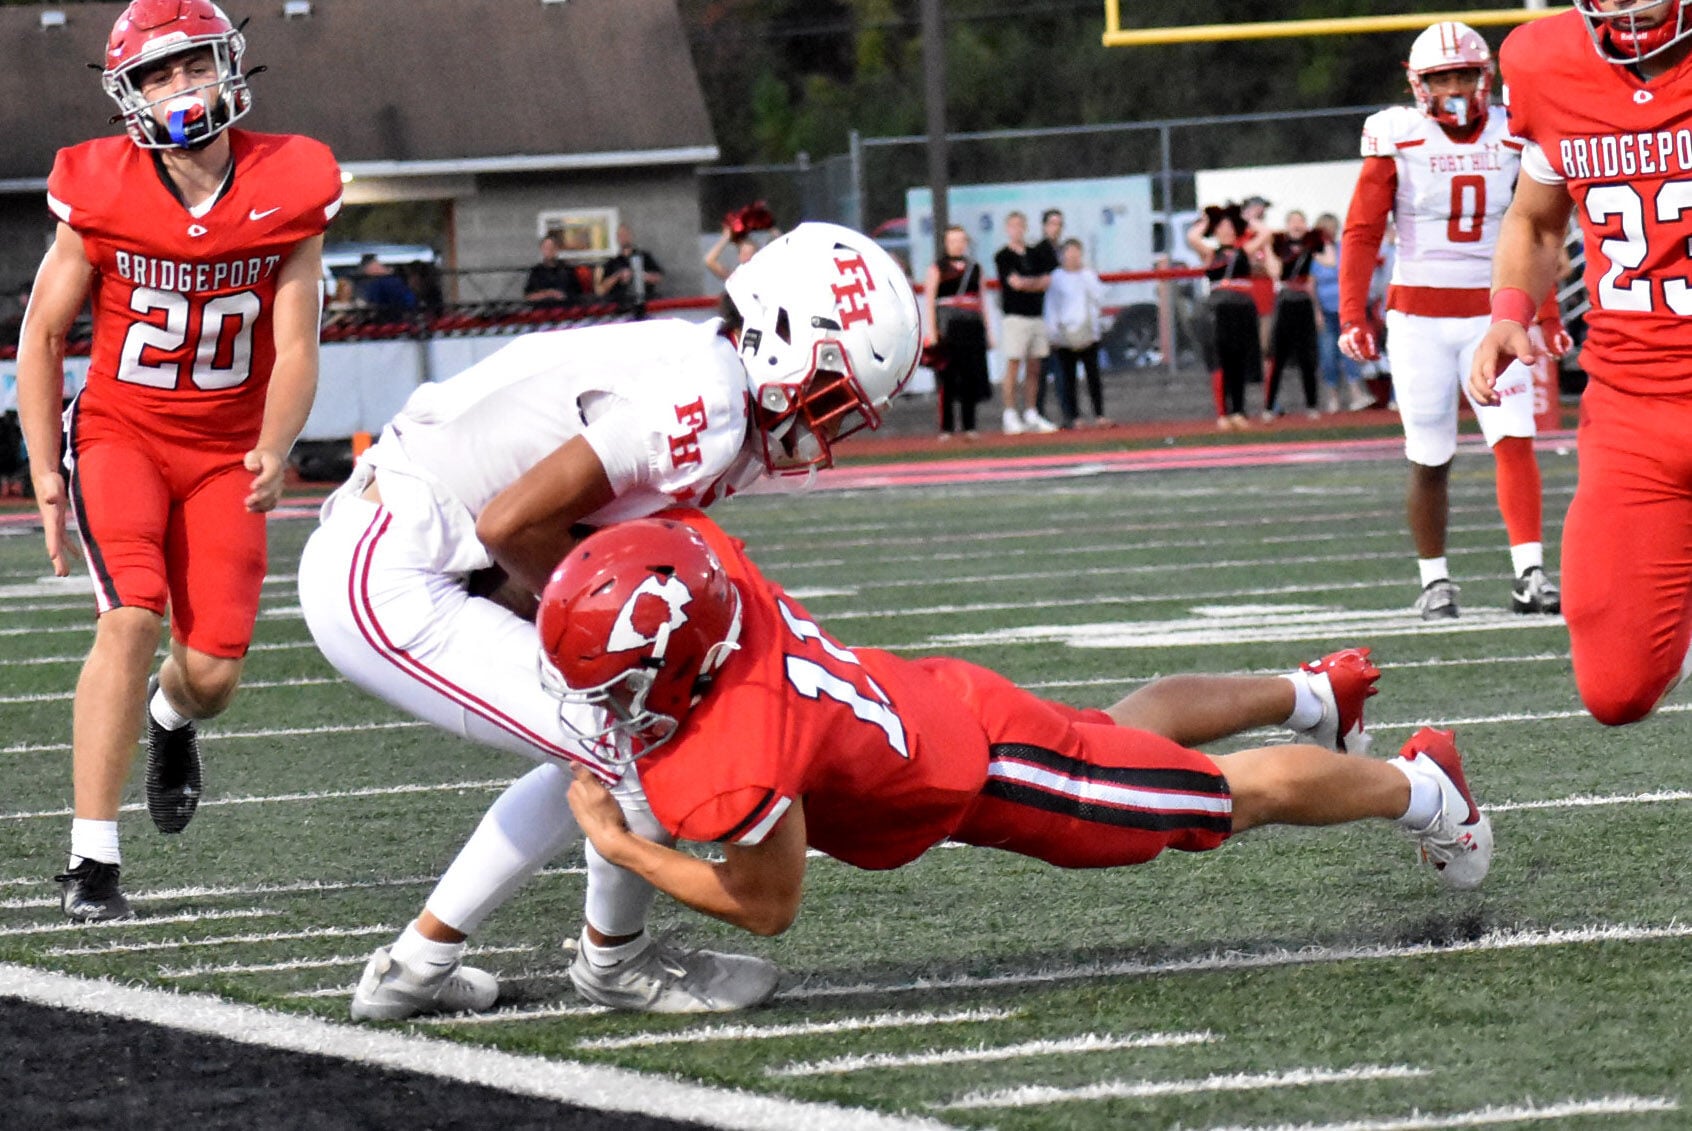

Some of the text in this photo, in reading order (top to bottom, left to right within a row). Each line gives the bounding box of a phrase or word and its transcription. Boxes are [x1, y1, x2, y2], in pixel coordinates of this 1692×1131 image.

[1429, 155, 1464, 172] FORT
[1447, 175, 1486, 242] 0
[115, 250, 280, 292] BRIDGEPORT
[831, 254, 877, 331] FH
[116, 285, 262, 391] 20
[668, 396, 709, 469] FH
